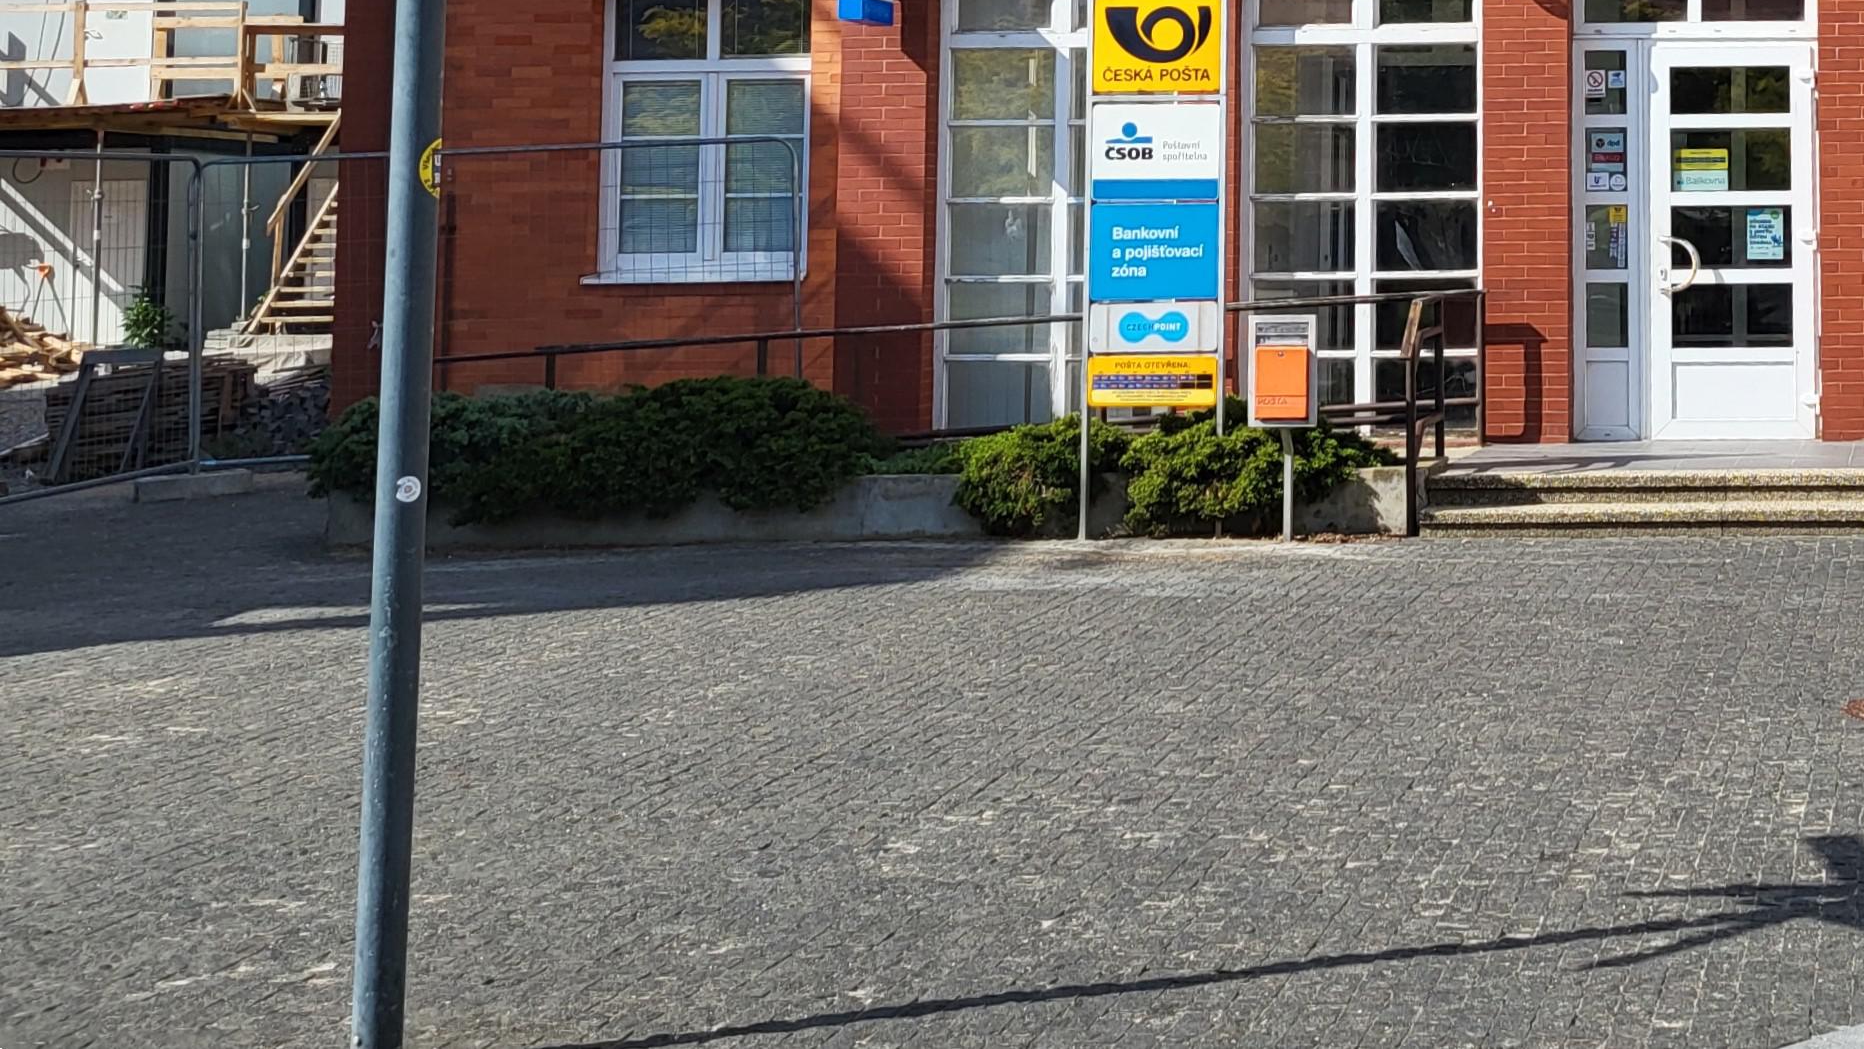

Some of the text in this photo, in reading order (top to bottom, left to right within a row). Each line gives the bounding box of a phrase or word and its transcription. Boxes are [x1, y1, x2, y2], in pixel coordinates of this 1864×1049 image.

[1102, 65, 1211, 82] ČESKÁ POŠTA
[1105, 145, 1154, 161] ČSOB
[1162, 140, 1201, 150] Poštovní
[1162, 151, 1208, 163] spořitelna
[1112, 225, 1179, 241] Bankovní
[1112, 244, 1204, 262] a pojišťovací
[1111, 264, 1147, 278] zóna
